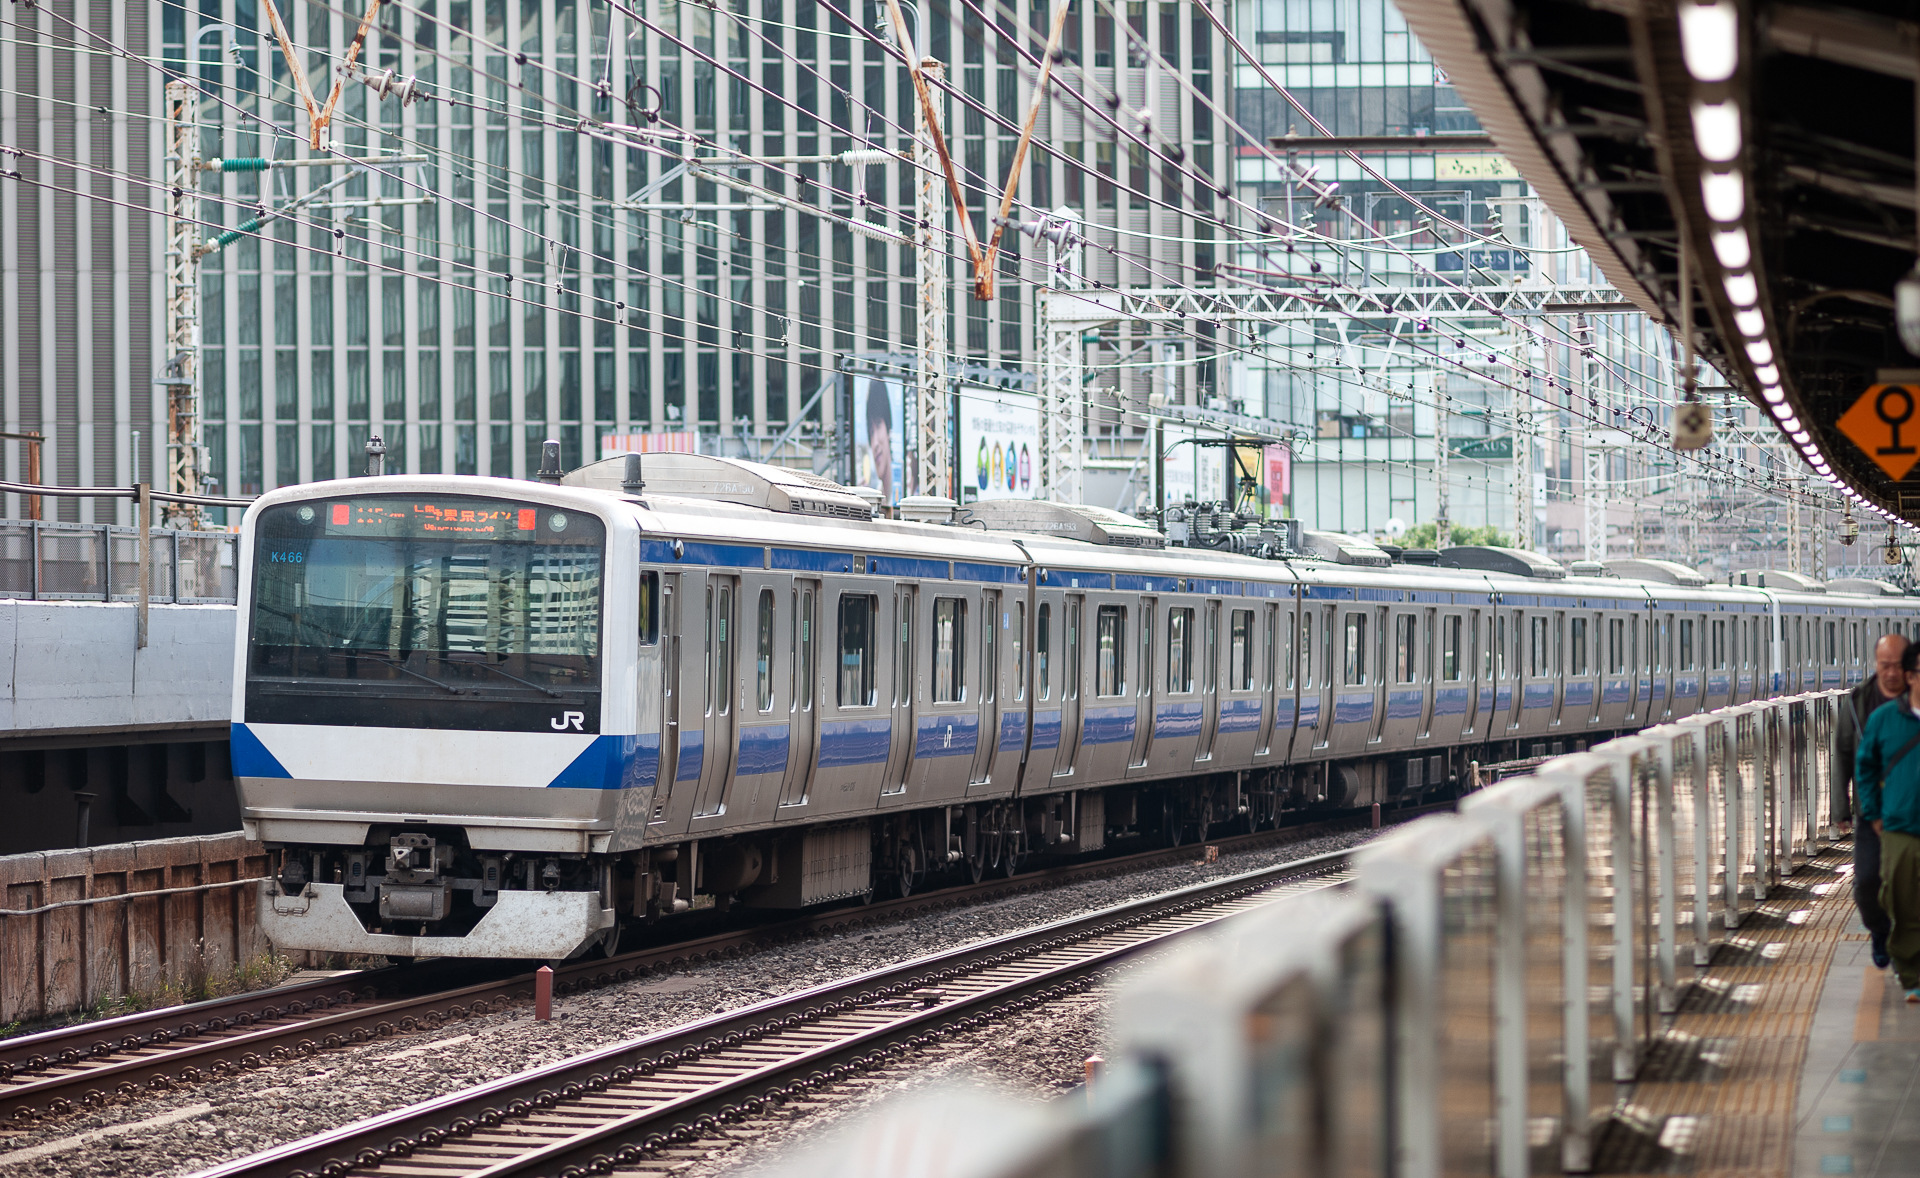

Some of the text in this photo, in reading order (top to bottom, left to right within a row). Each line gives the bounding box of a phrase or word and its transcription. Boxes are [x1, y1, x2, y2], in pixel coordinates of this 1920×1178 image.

[271, 551, 303, 563] K466
[551, 710, 585, 731] JR
[943, 724, 953, 748] JR
